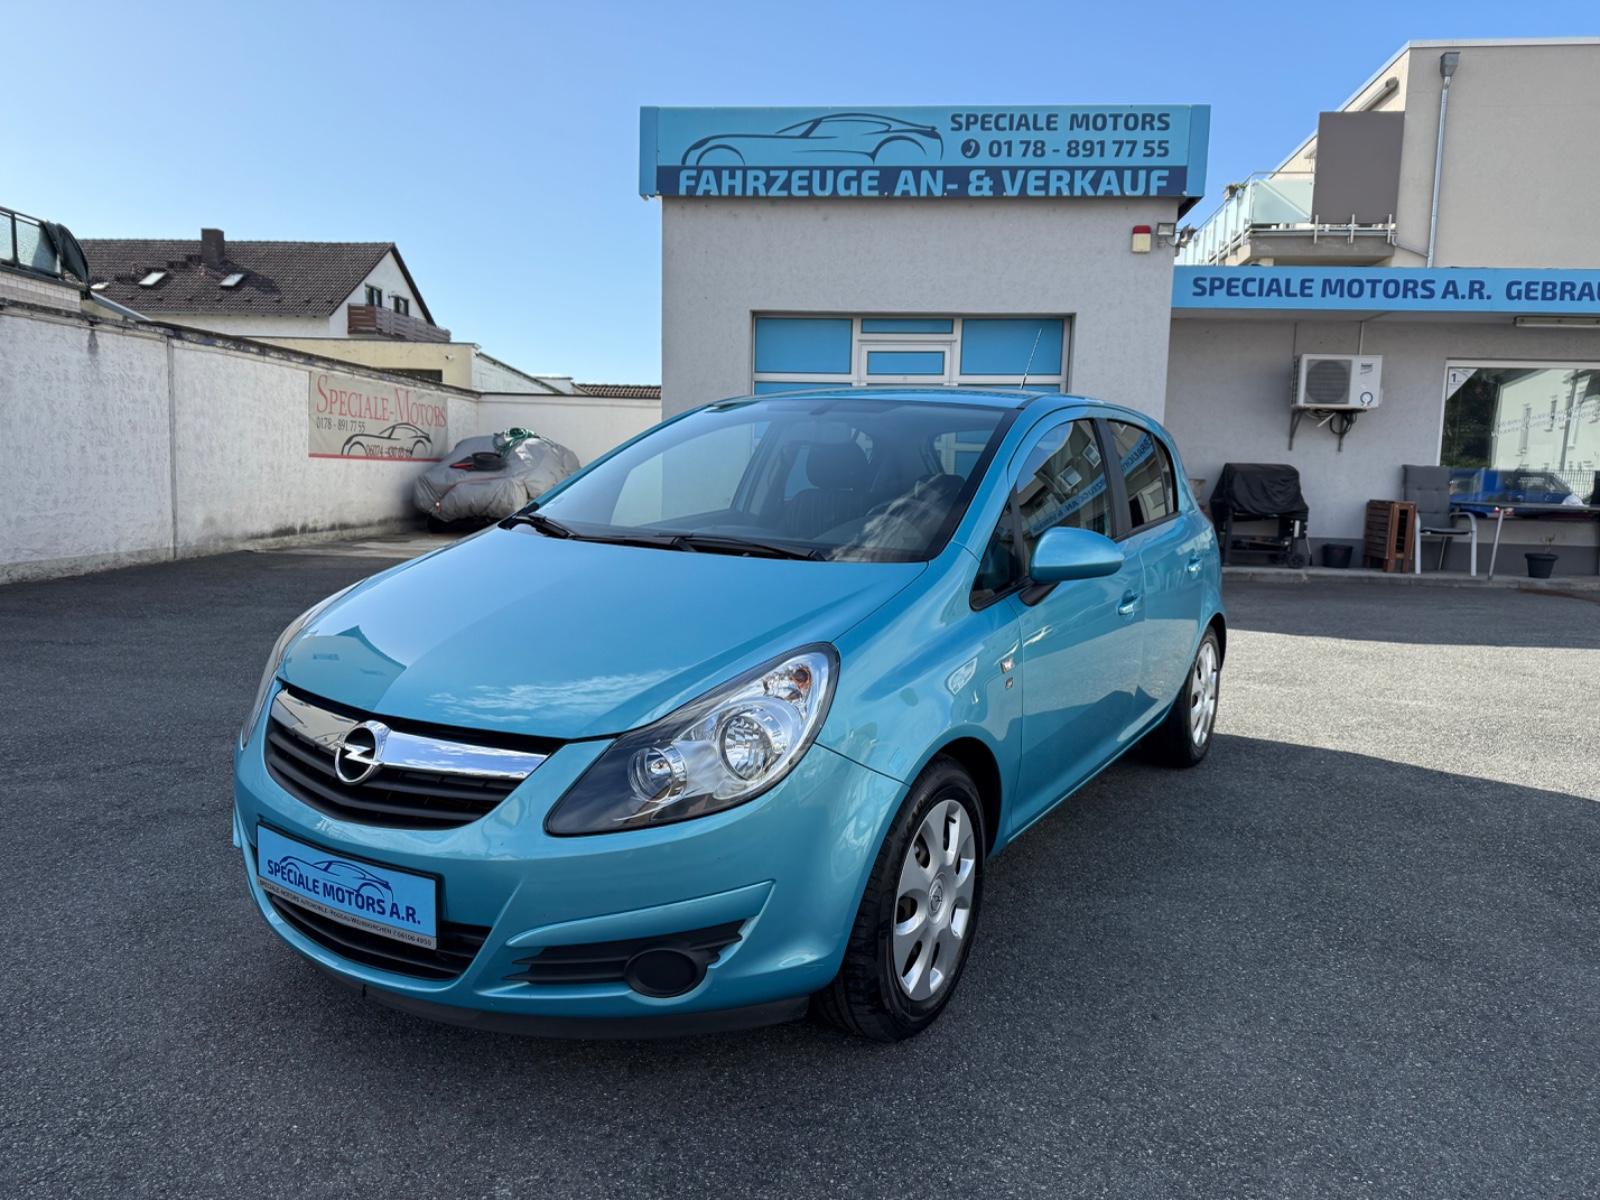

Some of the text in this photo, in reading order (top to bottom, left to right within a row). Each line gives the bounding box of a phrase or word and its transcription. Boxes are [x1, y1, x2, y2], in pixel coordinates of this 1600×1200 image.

[950, 113, 1171, 131] SPECIALE MOTORS
[678, 169, 1170, 197] FAHRZEUGE AN- & VERKAUF
[1192, 277, 1600, 301] SPECIALE MOTORS A.R. GEBRA
[267, 859, 320, 898] SPECIALE
[323, 882, 387, 915] MOTORS
[389, 903, 421, 925] A.R.
